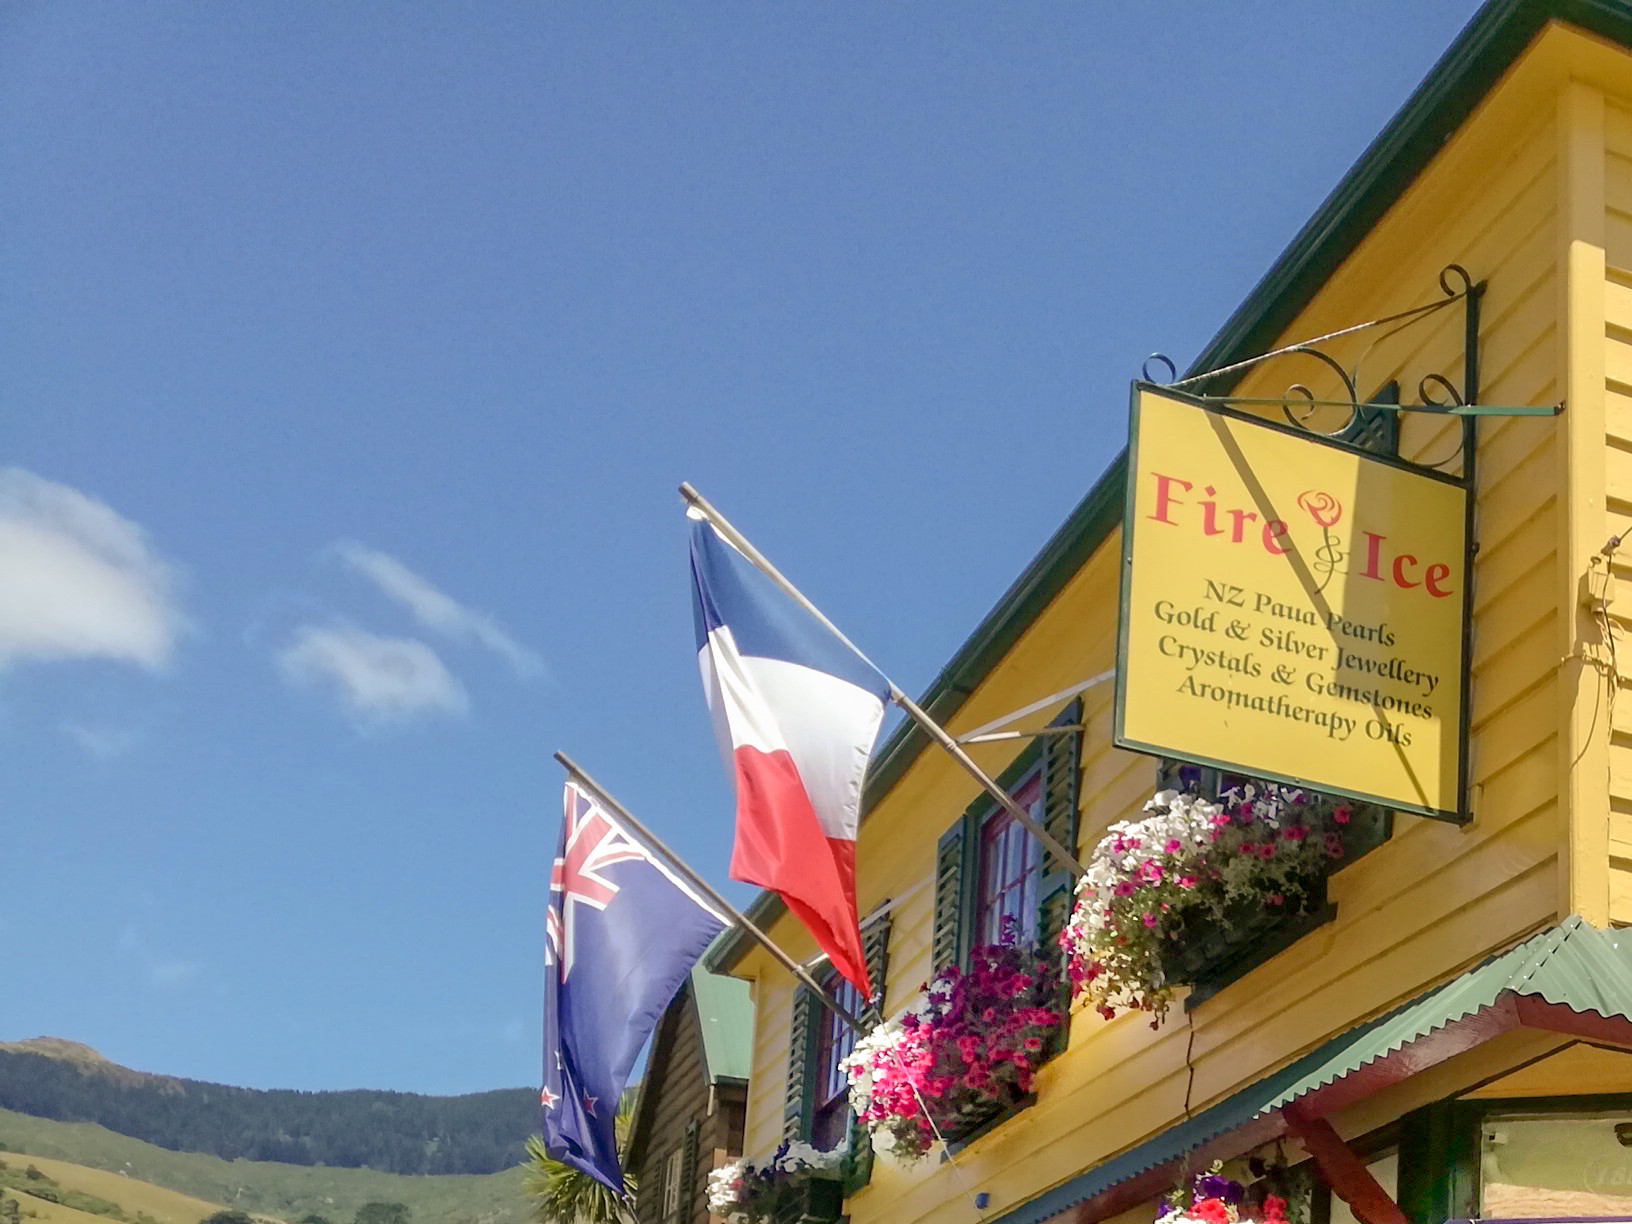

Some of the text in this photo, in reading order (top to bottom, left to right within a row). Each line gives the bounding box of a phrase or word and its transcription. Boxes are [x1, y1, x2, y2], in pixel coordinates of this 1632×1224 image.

[1146, 471, 1293, 555] Fire
[1358, 530, 1454, 598] Ice
[1154, 600, 1440, 697] Gold & Silver Jewellery
[1203, 578, 1396, 647] NZ Paua Pearls
[1158, 634, 1433, 720] Crystals & Gemstones
[1176, 674, 1412, 747] Aromatherapy Oils
